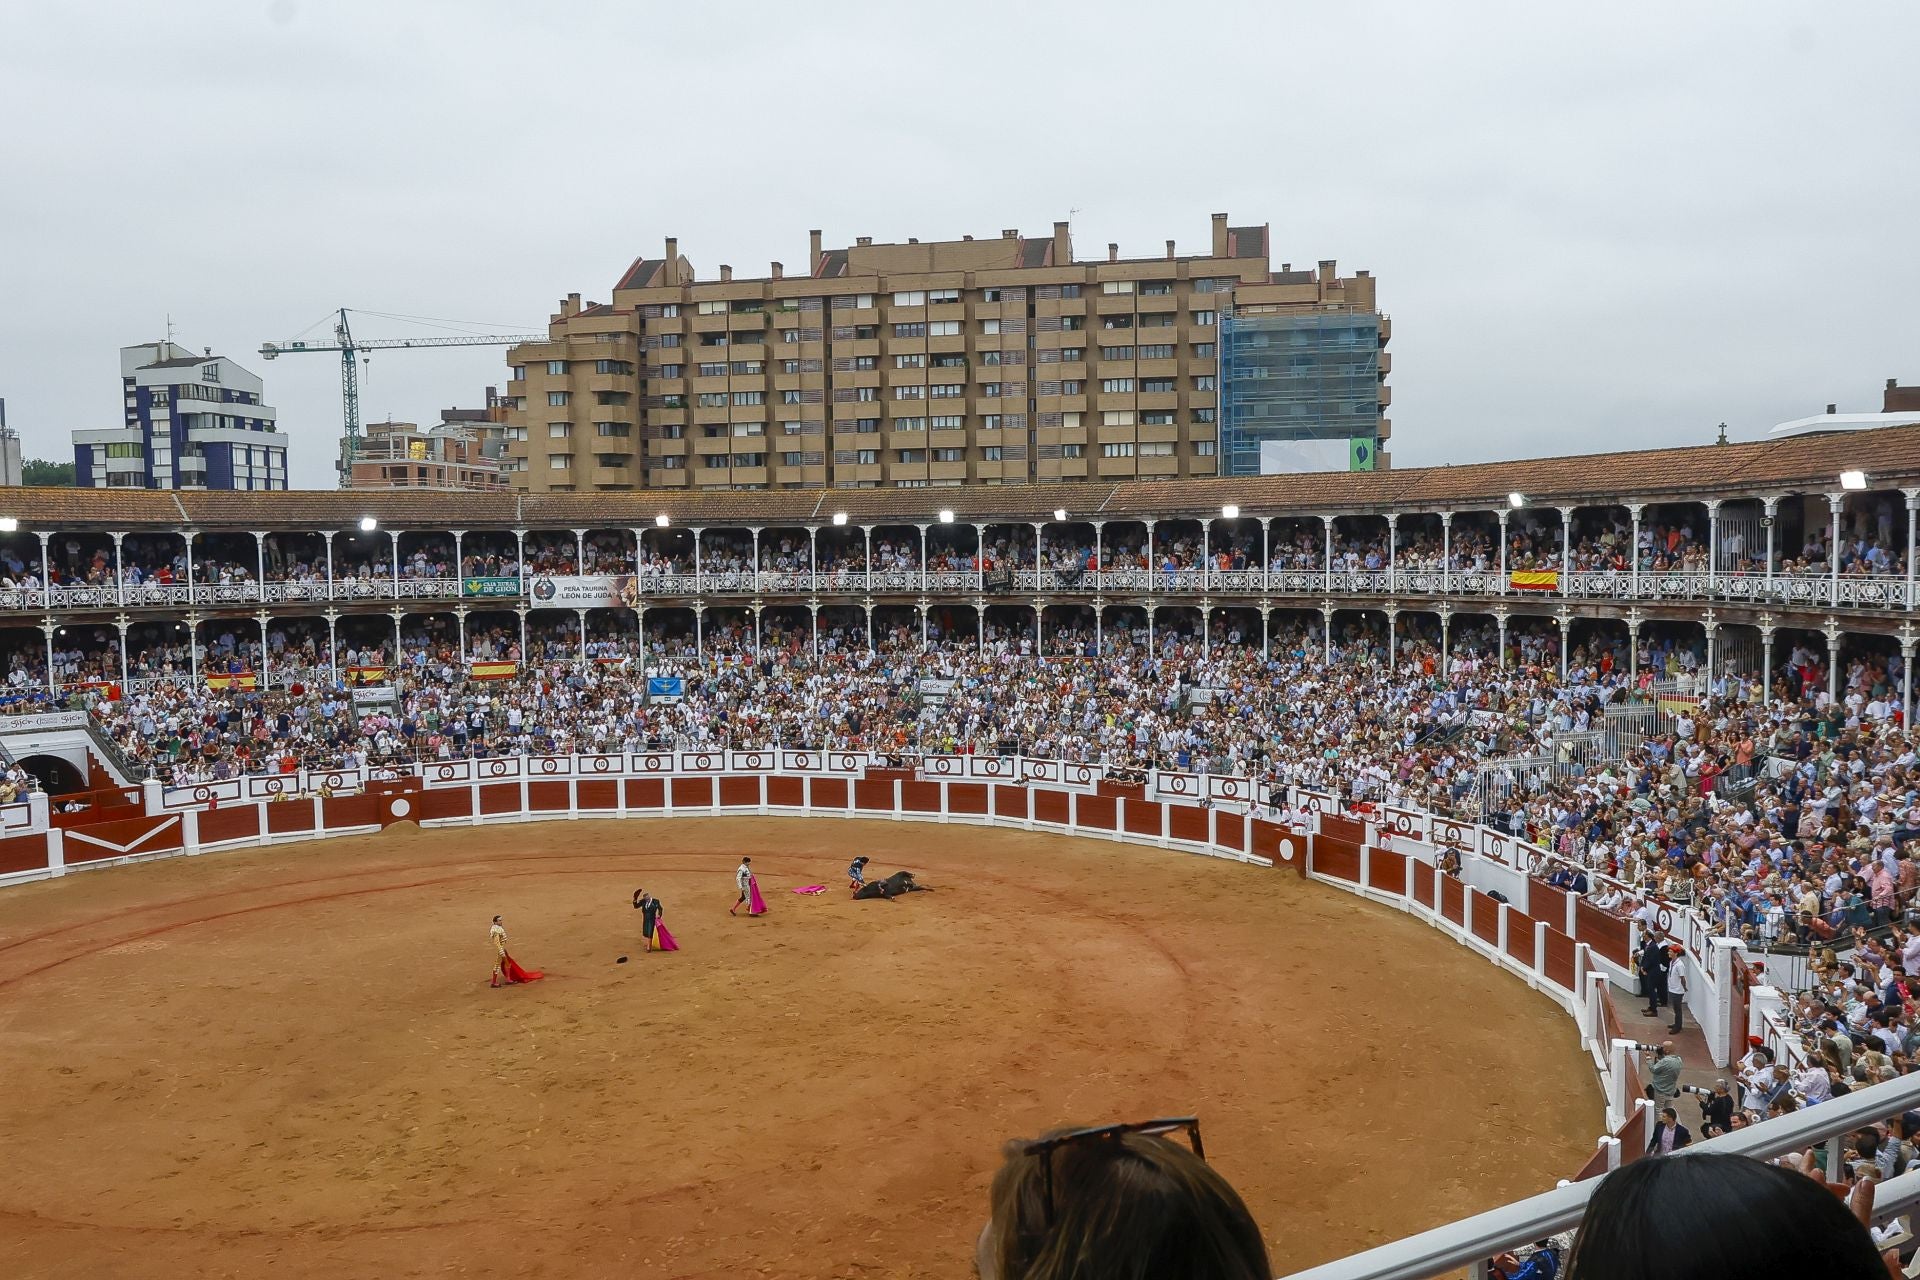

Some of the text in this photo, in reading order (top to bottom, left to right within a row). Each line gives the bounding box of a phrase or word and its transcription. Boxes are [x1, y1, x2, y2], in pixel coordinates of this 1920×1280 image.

[330, 777, 339, 785] 12
[270, 782, 278, 790] 12
[1661, 914, 1666, 925] 2
